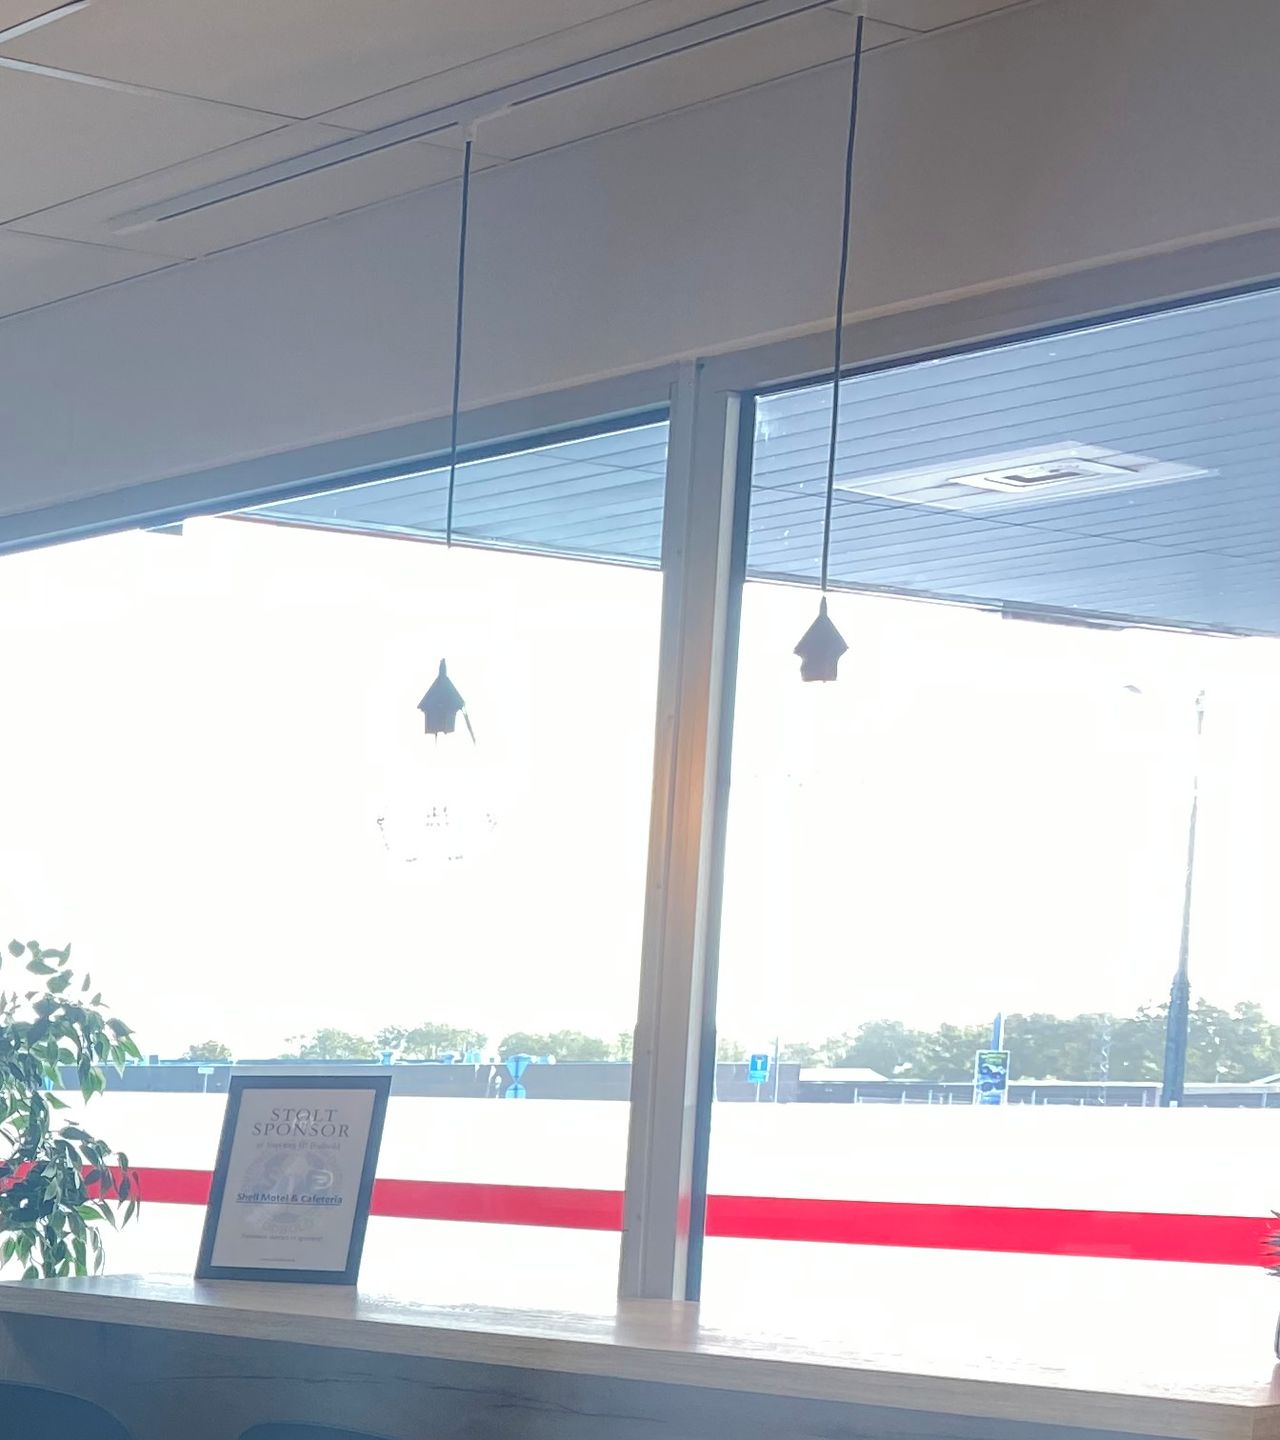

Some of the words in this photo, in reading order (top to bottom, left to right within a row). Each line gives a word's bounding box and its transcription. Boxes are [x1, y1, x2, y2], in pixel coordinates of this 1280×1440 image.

[270, 1107, 338, 1122] STOLT
[251, 1122, 351, 1138] SPONSOR
[237, 1192, 260, 1202] Shell
[261, 1192, 290, 1203] Motel
[291, 1193, 298, 1203] &
[300, 1193, 344, 1205] Cafeteria
